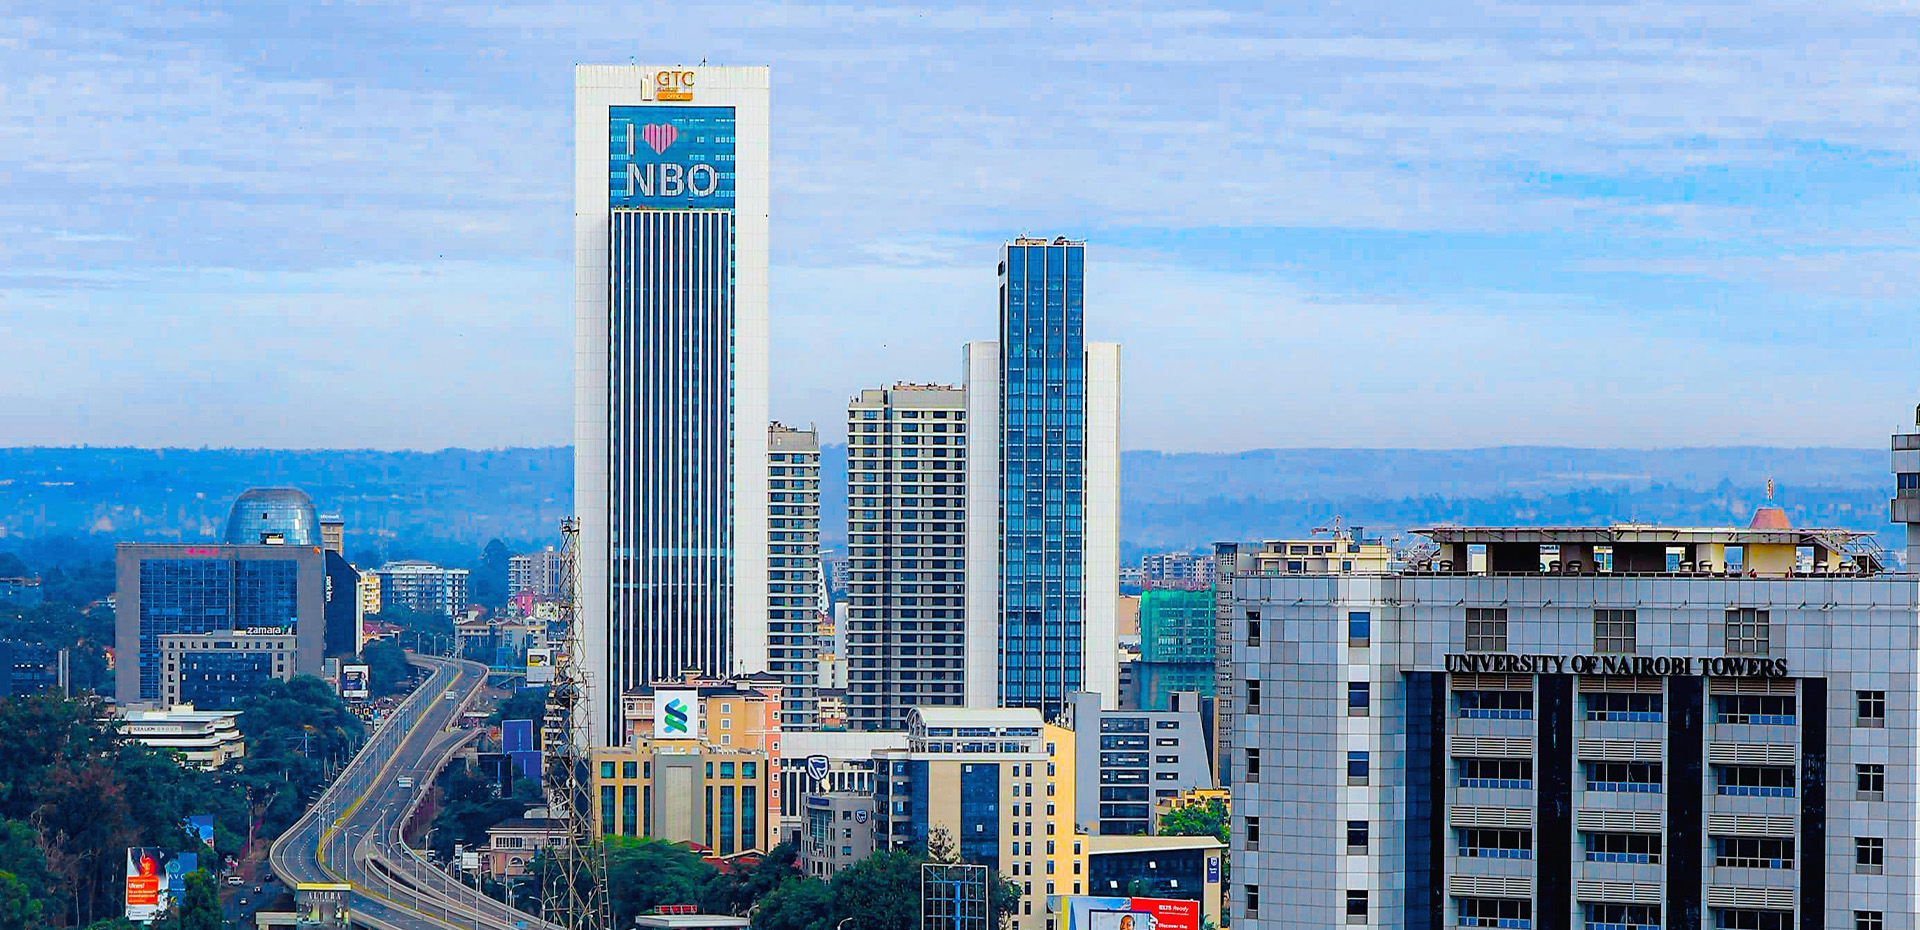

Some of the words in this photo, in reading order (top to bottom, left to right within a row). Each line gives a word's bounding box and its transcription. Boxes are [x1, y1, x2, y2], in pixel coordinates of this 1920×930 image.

[656, 70, 695, 87] GTC
[626, 123, 635, 156] I
[626, 163, 718, 197] NBO
[247, 626, 282, 636] zamara
[1444, 653, 1566, 673] UNIVERSITY
[1570, 654, 1599, 674] OF
[1600, 655, 1693, 676] NAIROBI
[1697, 656, 1788, 677] TOWERS
